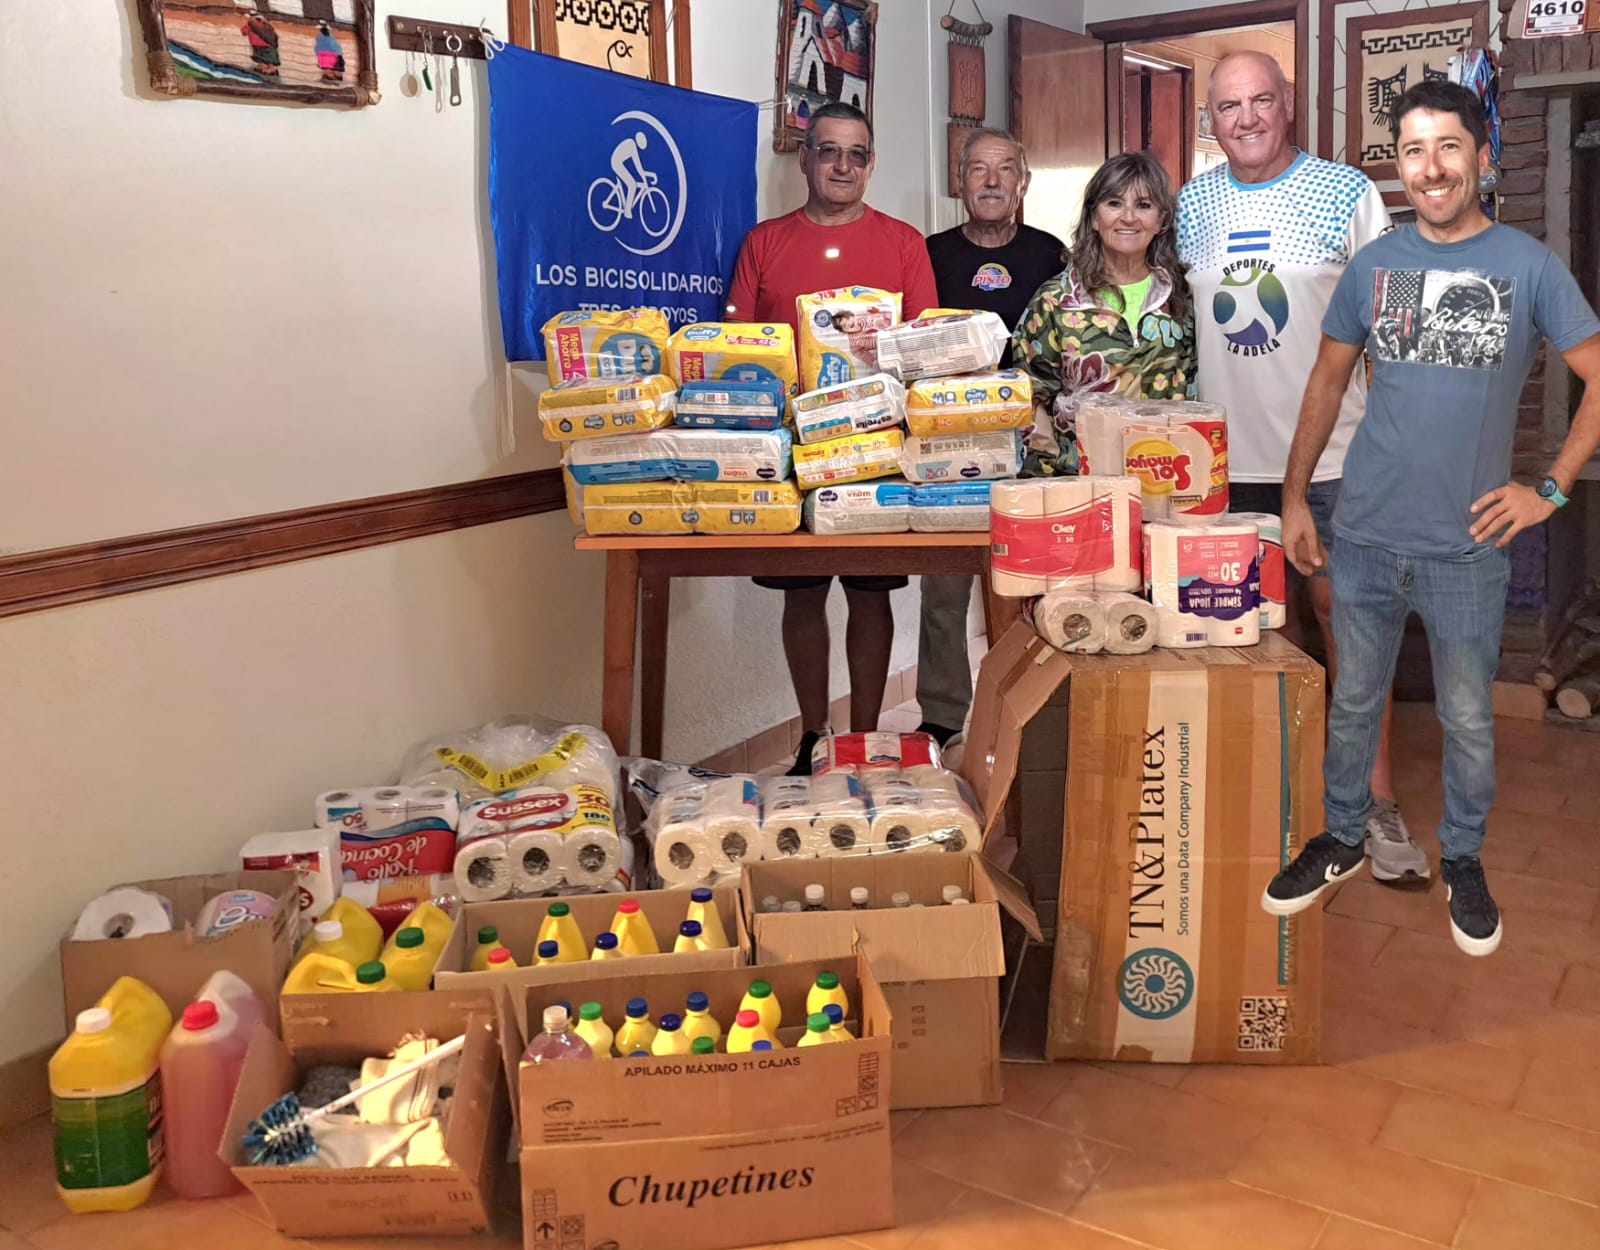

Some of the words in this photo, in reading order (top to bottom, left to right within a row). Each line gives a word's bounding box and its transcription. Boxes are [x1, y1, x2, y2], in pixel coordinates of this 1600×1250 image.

[1531, 1, 1584, 16] 4610
[1222, 258, 1276, 276] DEPORTES
[536, 264, 577, 286] LOS
[585, 266, 723, 295] BICISOLIDARIOS
[972, 275, 1011, 286] PINTO
[559, 333, 571, 369] Ahorro
[569, 332, 580, 360] Mega
[1227, 340, 1240, 355] LA
[1243, 338, 1281, 357] ADELA
[1154, 454, 1192, 491] Sol
[1220, 562, 1241, 582] 30
[1177, 722, 1190, 778] Industrial
[483, 797, 562, 819] Sussex
[1177, 780, 1192, 838] Company
[1128, 726, 1165, 939] TN&Platex
[341, 843, 405, 865] Cocina
[405, 835, 428, 855] de
[1177, 841, 1190, 869] Data
[367, 858, 419, 881] Rollo
[1180, 870, 1190, 894] una
[1177, 897, 1190, 936] Somos
[624, 1065, 682, 1078] APILADO
[743, 1061, 754, 1072] 11
[758, 1056, 801, 1070] CAJAS
[608, 1164, 816, 1209] Chupetines
